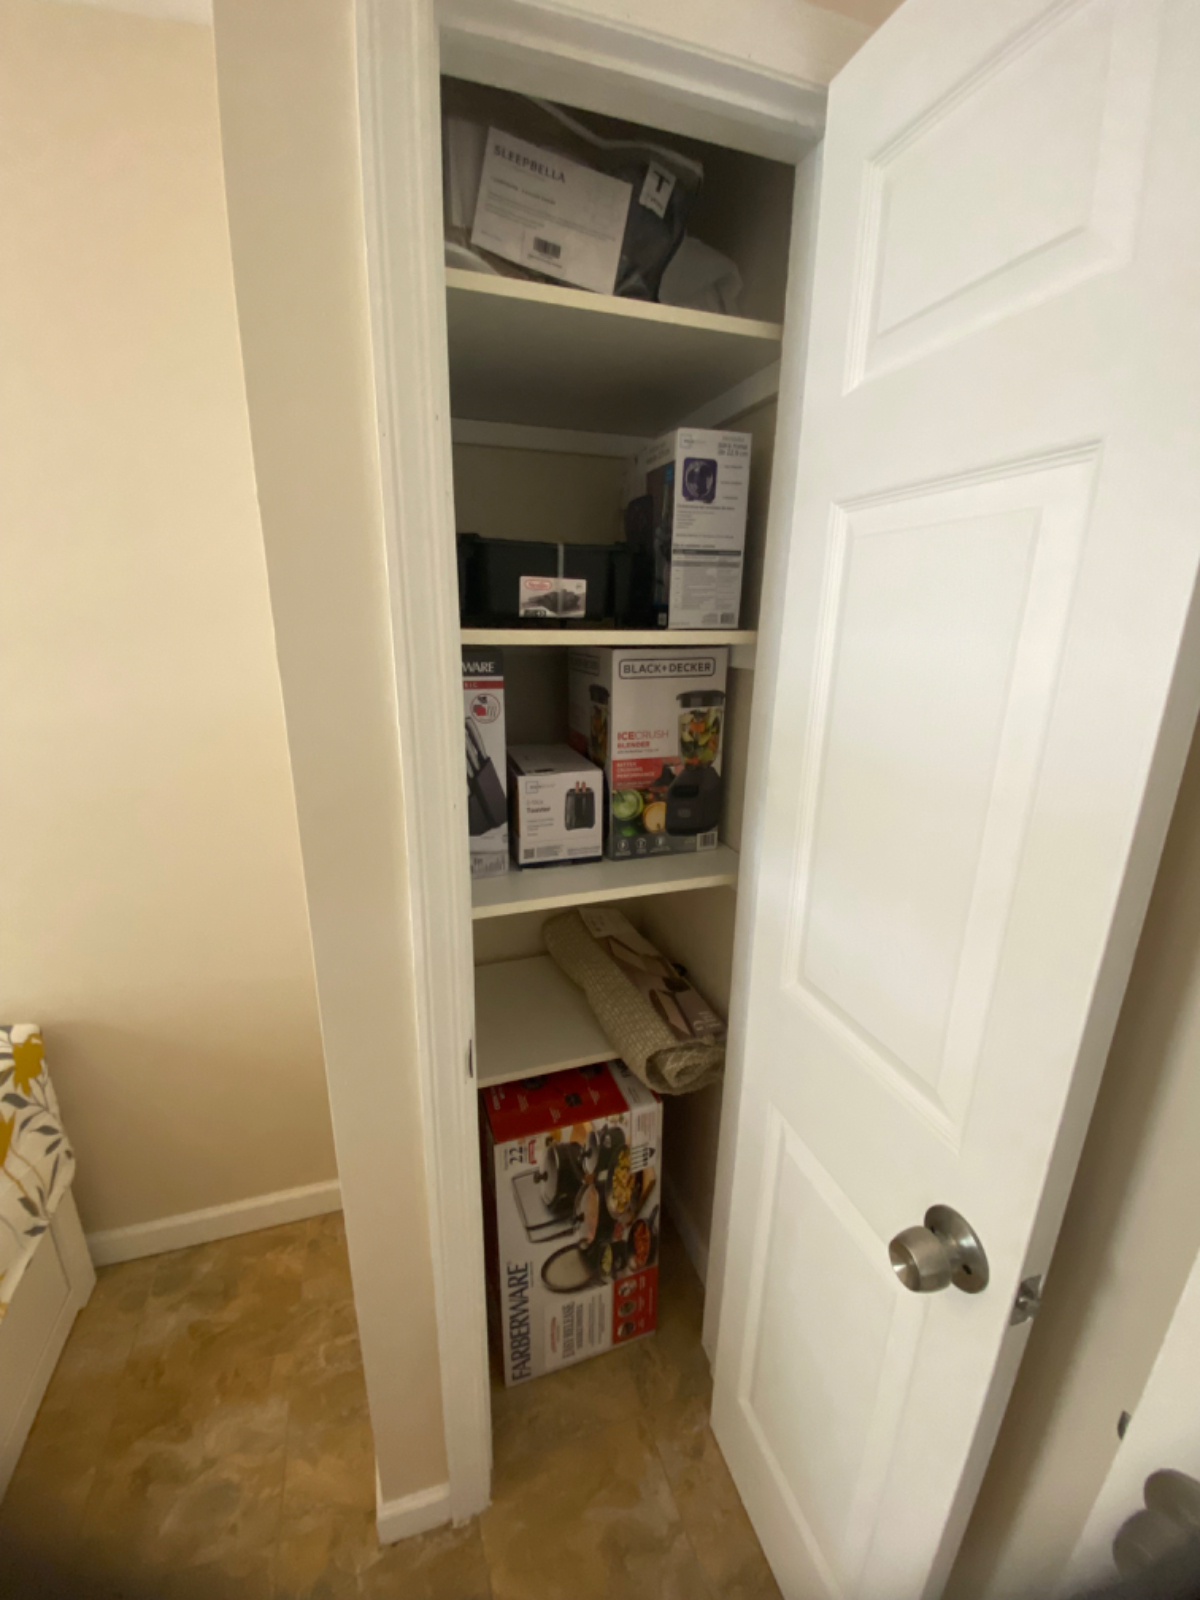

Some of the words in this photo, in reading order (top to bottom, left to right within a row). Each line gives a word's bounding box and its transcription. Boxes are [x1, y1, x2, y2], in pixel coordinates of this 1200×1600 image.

[494, 145, 566, 183] SLEEPBELLA
[653, 170, 671, 193] T
[623, 662, 711, 674] BLACK+DECKER
[617, 730, 669, 741] ICECRUSH
[617, 741, 650, 749] BLENDER
[527, 806, 551, 814] Toaster
[509, 1146, 523, 1166] 22
[507, 1261, 531, 1381] FARBERWARE
